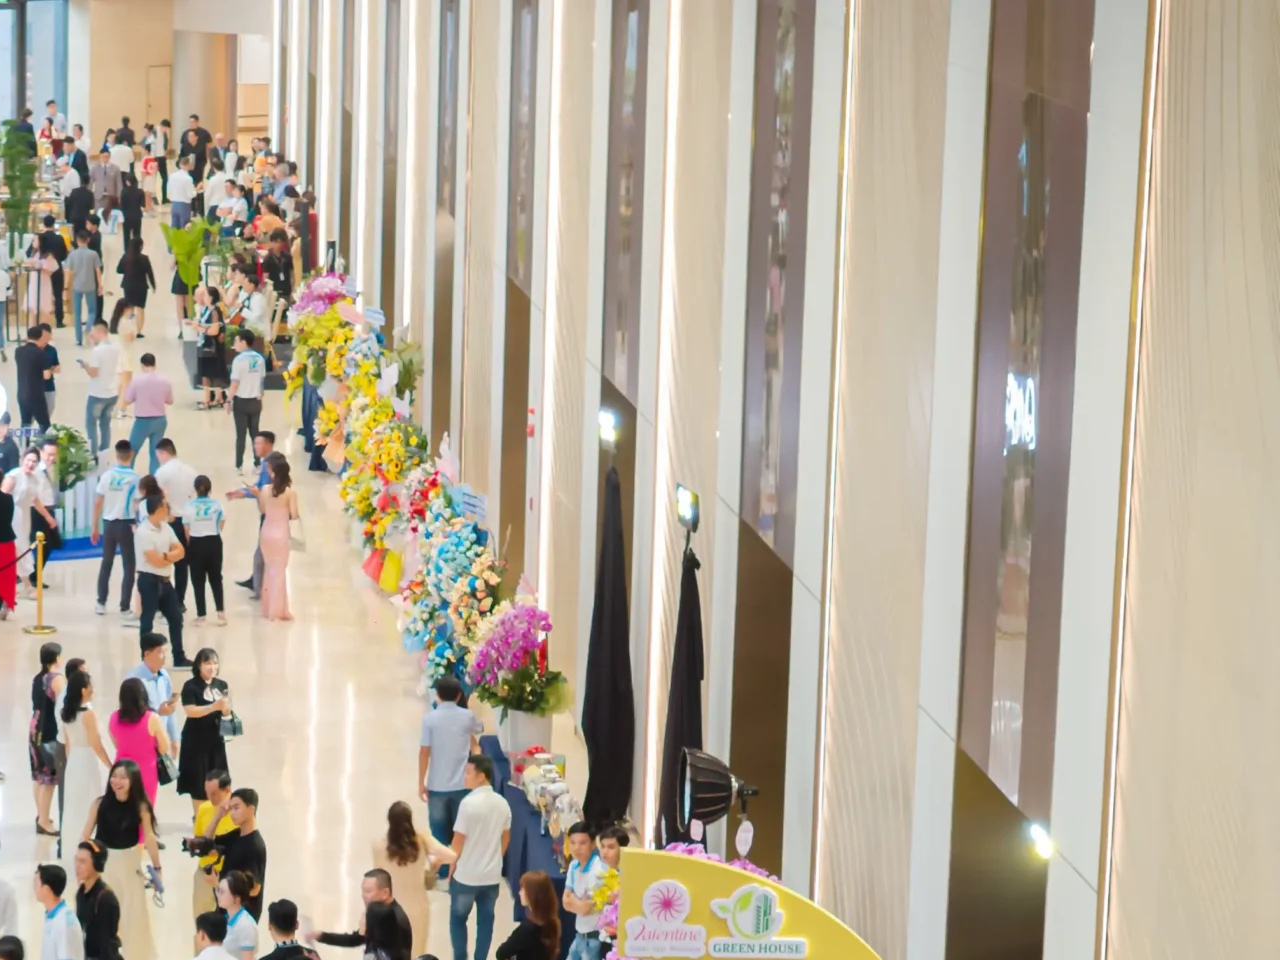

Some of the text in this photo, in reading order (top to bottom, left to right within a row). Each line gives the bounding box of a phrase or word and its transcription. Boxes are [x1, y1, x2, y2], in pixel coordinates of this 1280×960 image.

[634, 924, 701, 942] Valentine
[713, 943, 755, 954] GREEN
[758, 943, 802, 954] HOUSE
